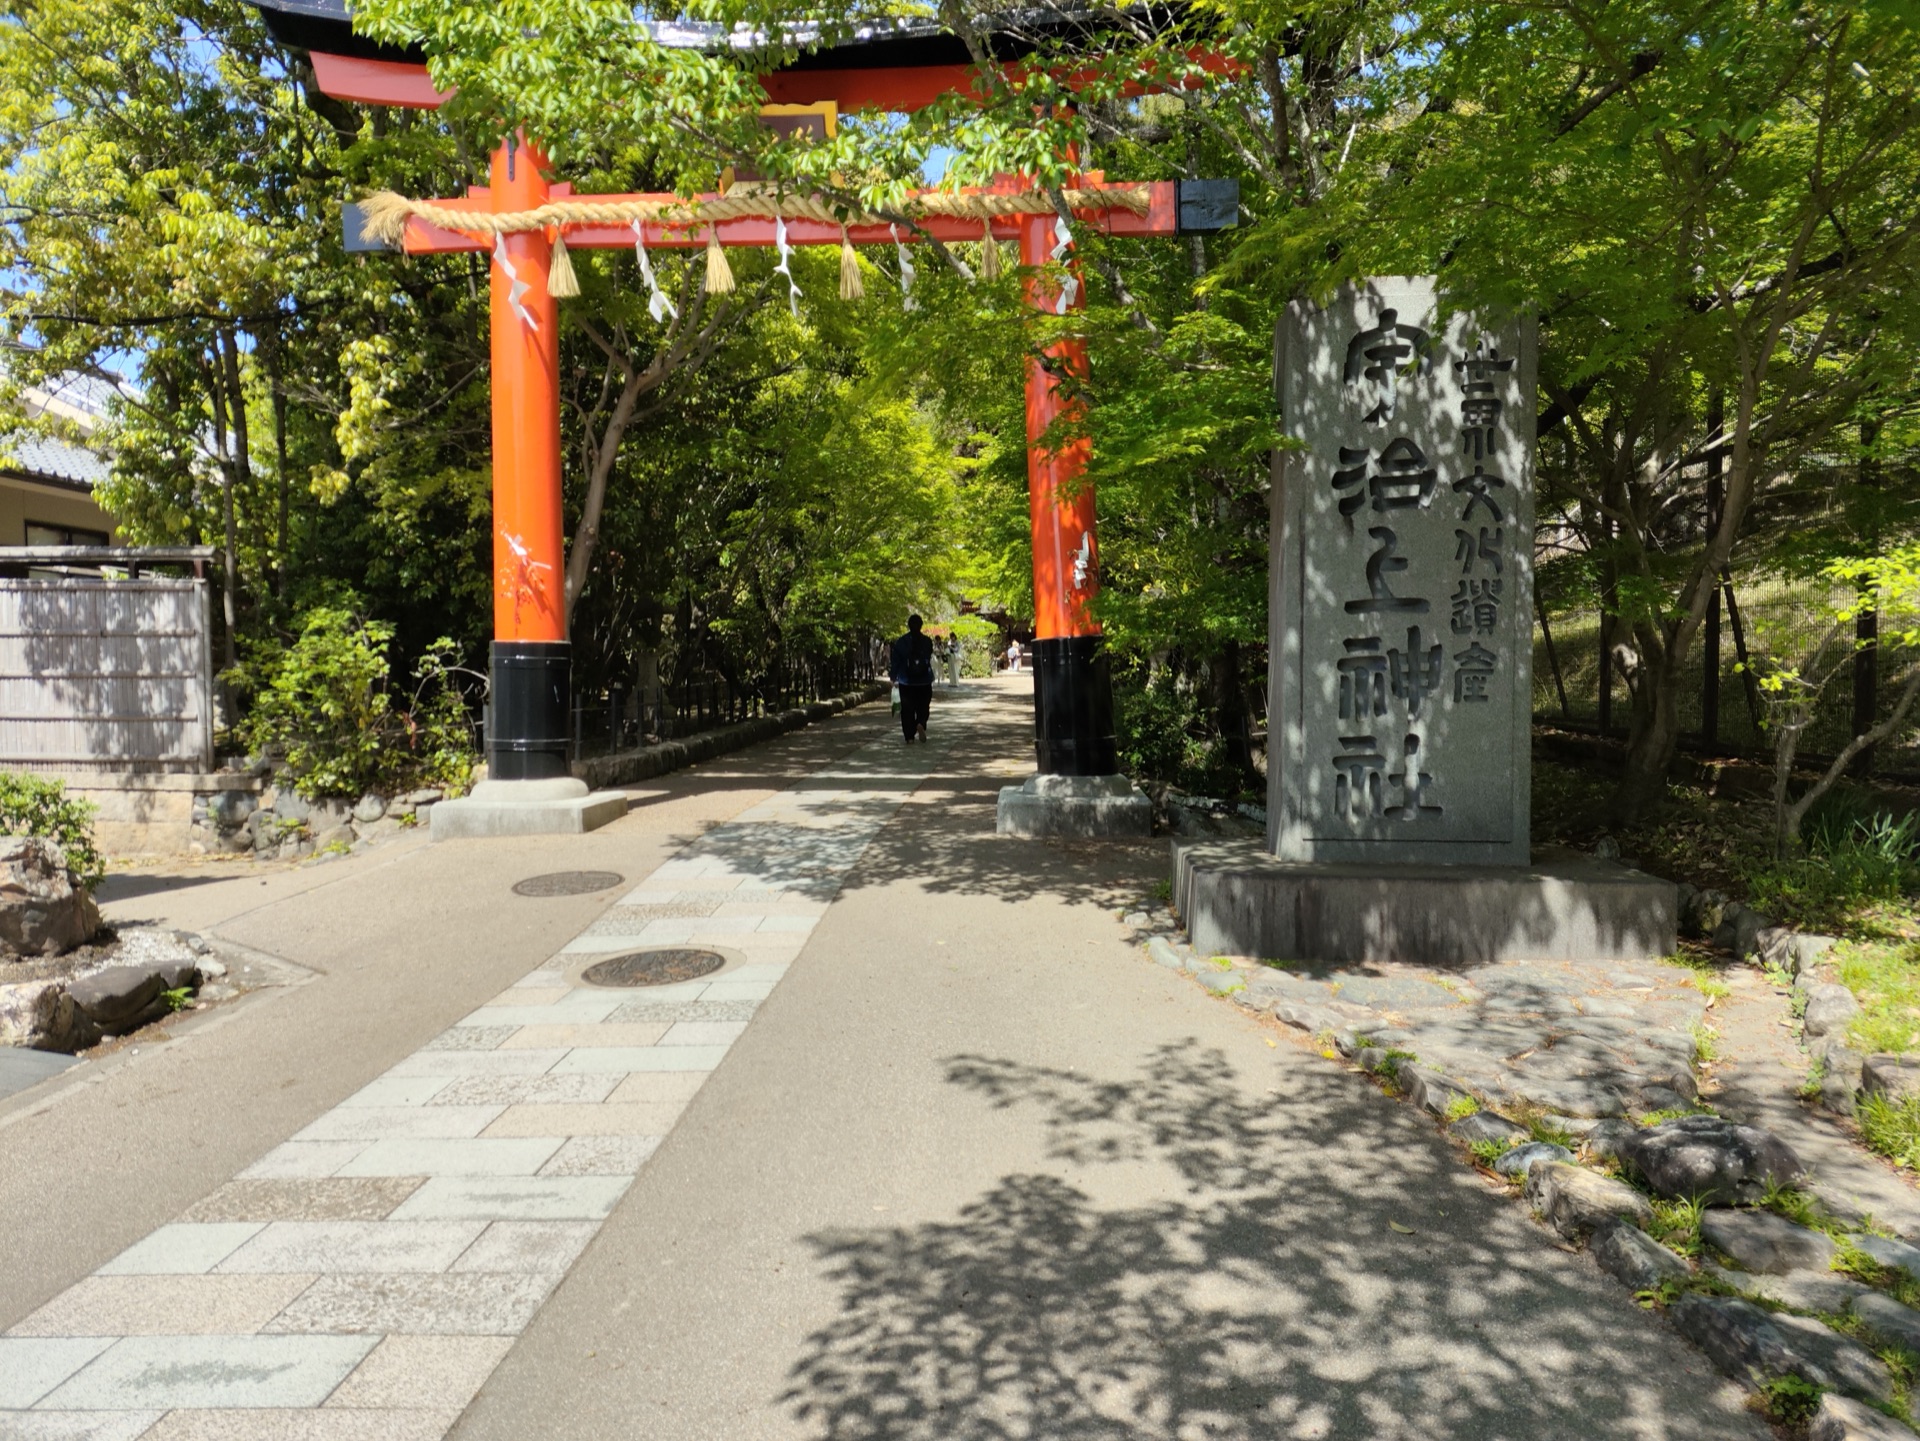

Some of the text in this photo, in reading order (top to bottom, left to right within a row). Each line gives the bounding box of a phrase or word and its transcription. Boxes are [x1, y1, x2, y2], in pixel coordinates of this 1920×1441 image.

[1331, 308, 1443, 822] 宇治上神社
